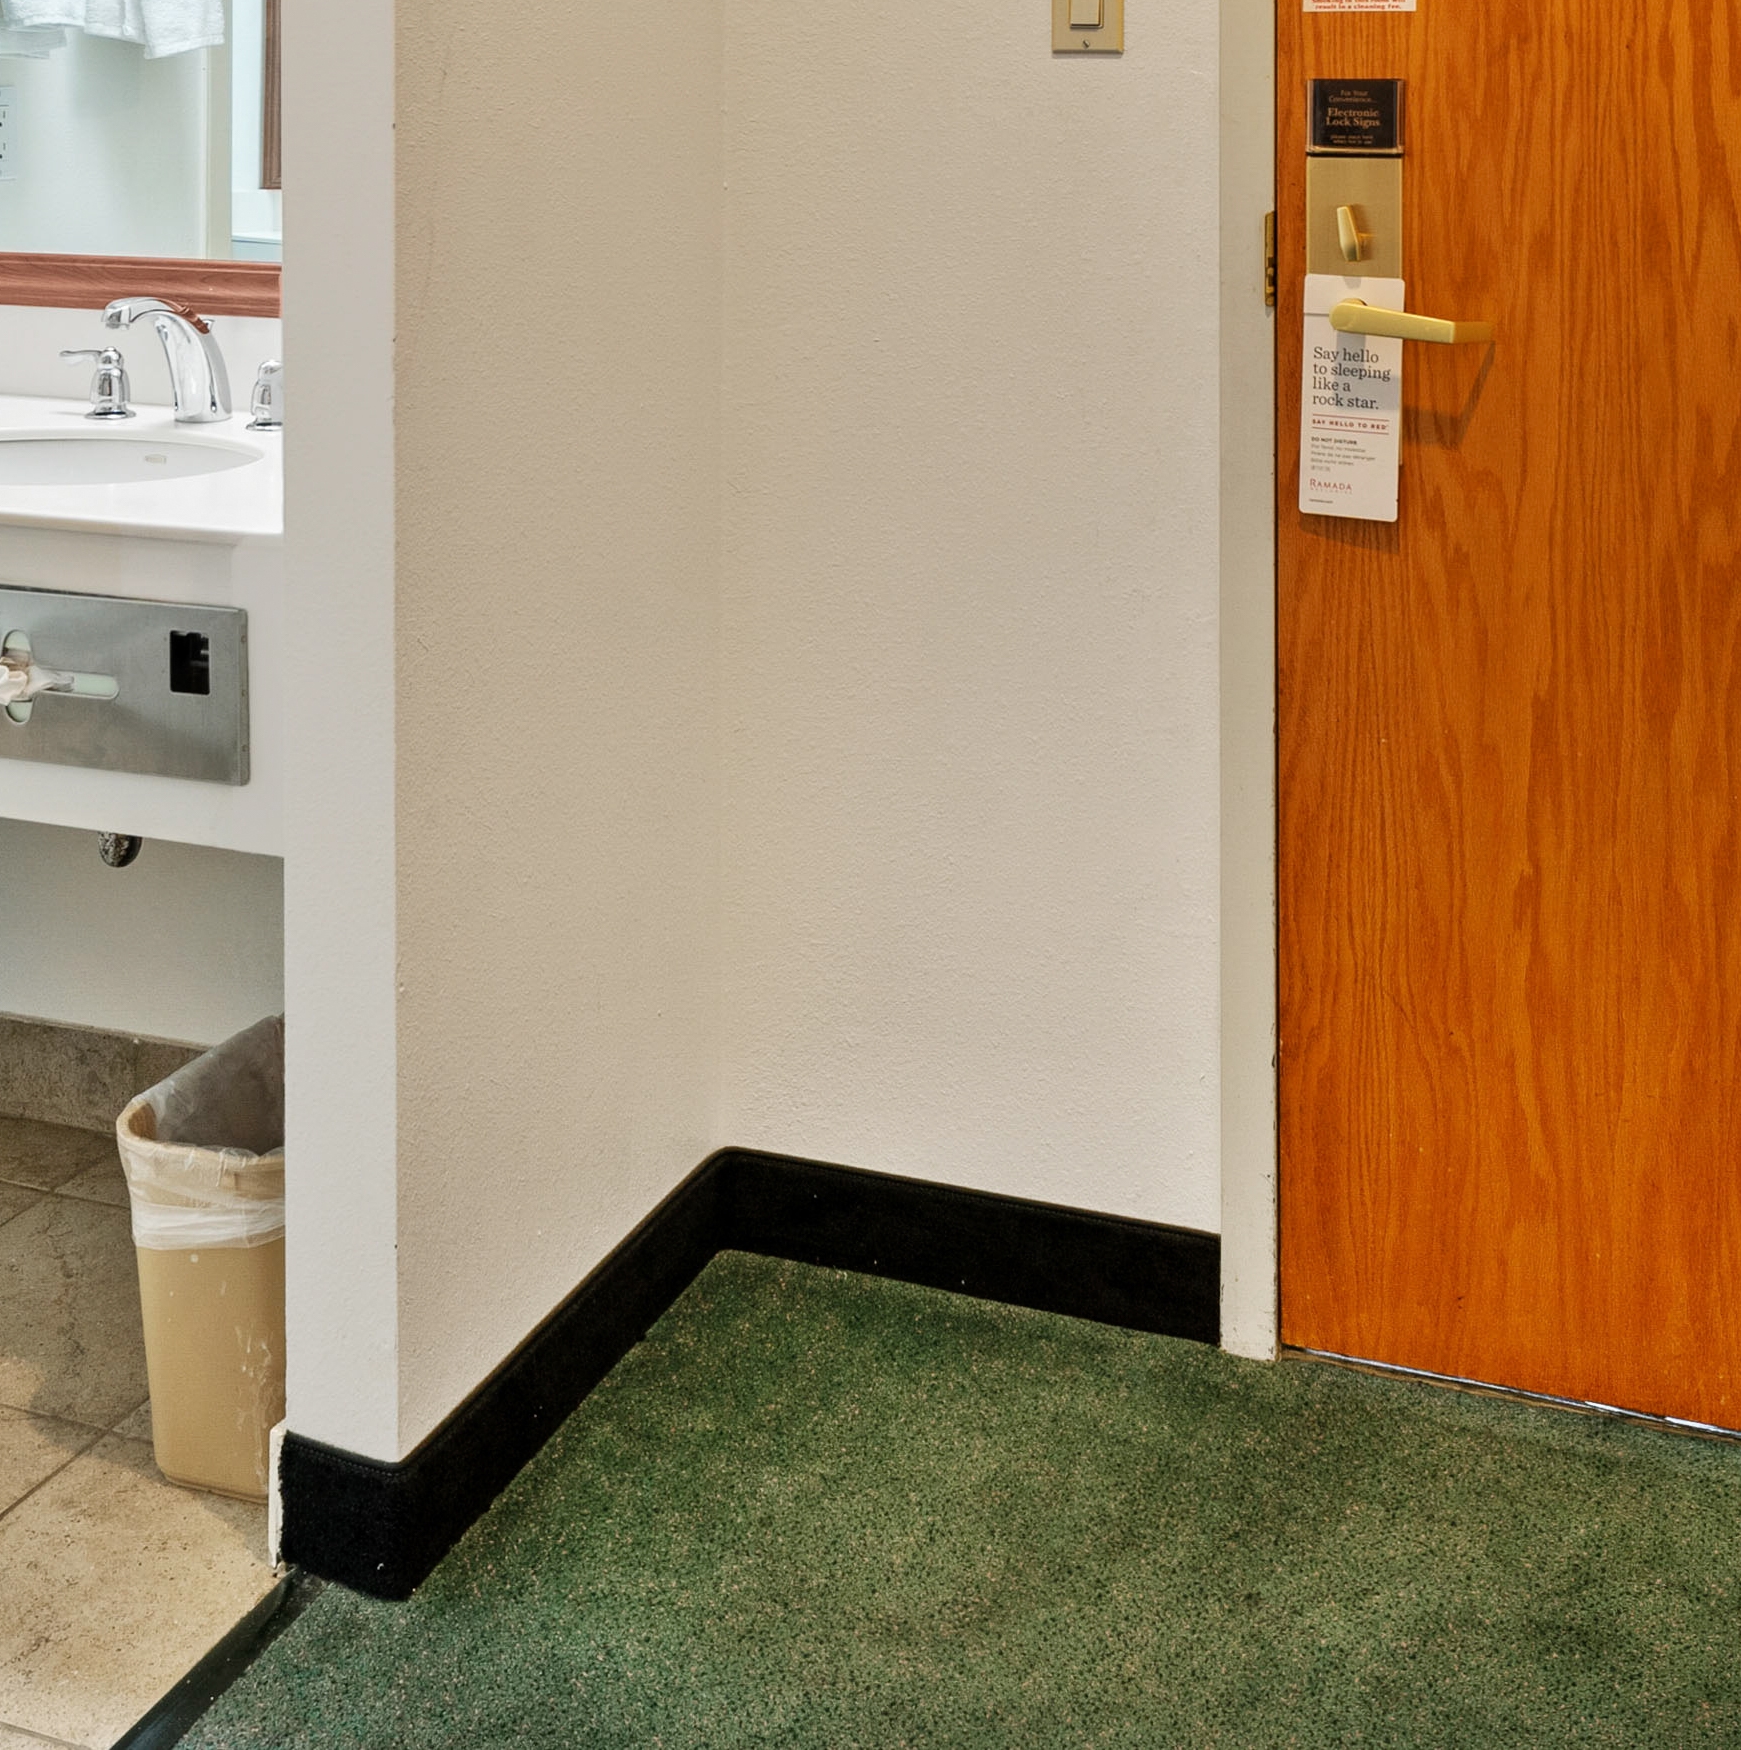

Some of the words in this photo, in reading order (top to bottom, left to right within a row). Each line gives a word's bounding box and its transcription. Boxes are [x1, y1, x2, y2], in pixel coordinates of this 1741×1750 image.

[1327, 107, 1380, 117] Electronic
[1325, 116, 1350, 126] Lock
[1353, 117, 1381, 129] Signs
[1313, 346, 1339, 363] Say
[1343, 347, 1379, 363] hello
[1313, 363, 1327, 375] to
[1330, 362, 1392, 382] sleeping
[1313, 376, 1339, 391] like
[1343, 381, 1351, 392] a
[1312, 393, 1343, 406] rock
[1347, 396, 1379, 410] star.
[1329, 420, 1354, 428] HELLO
